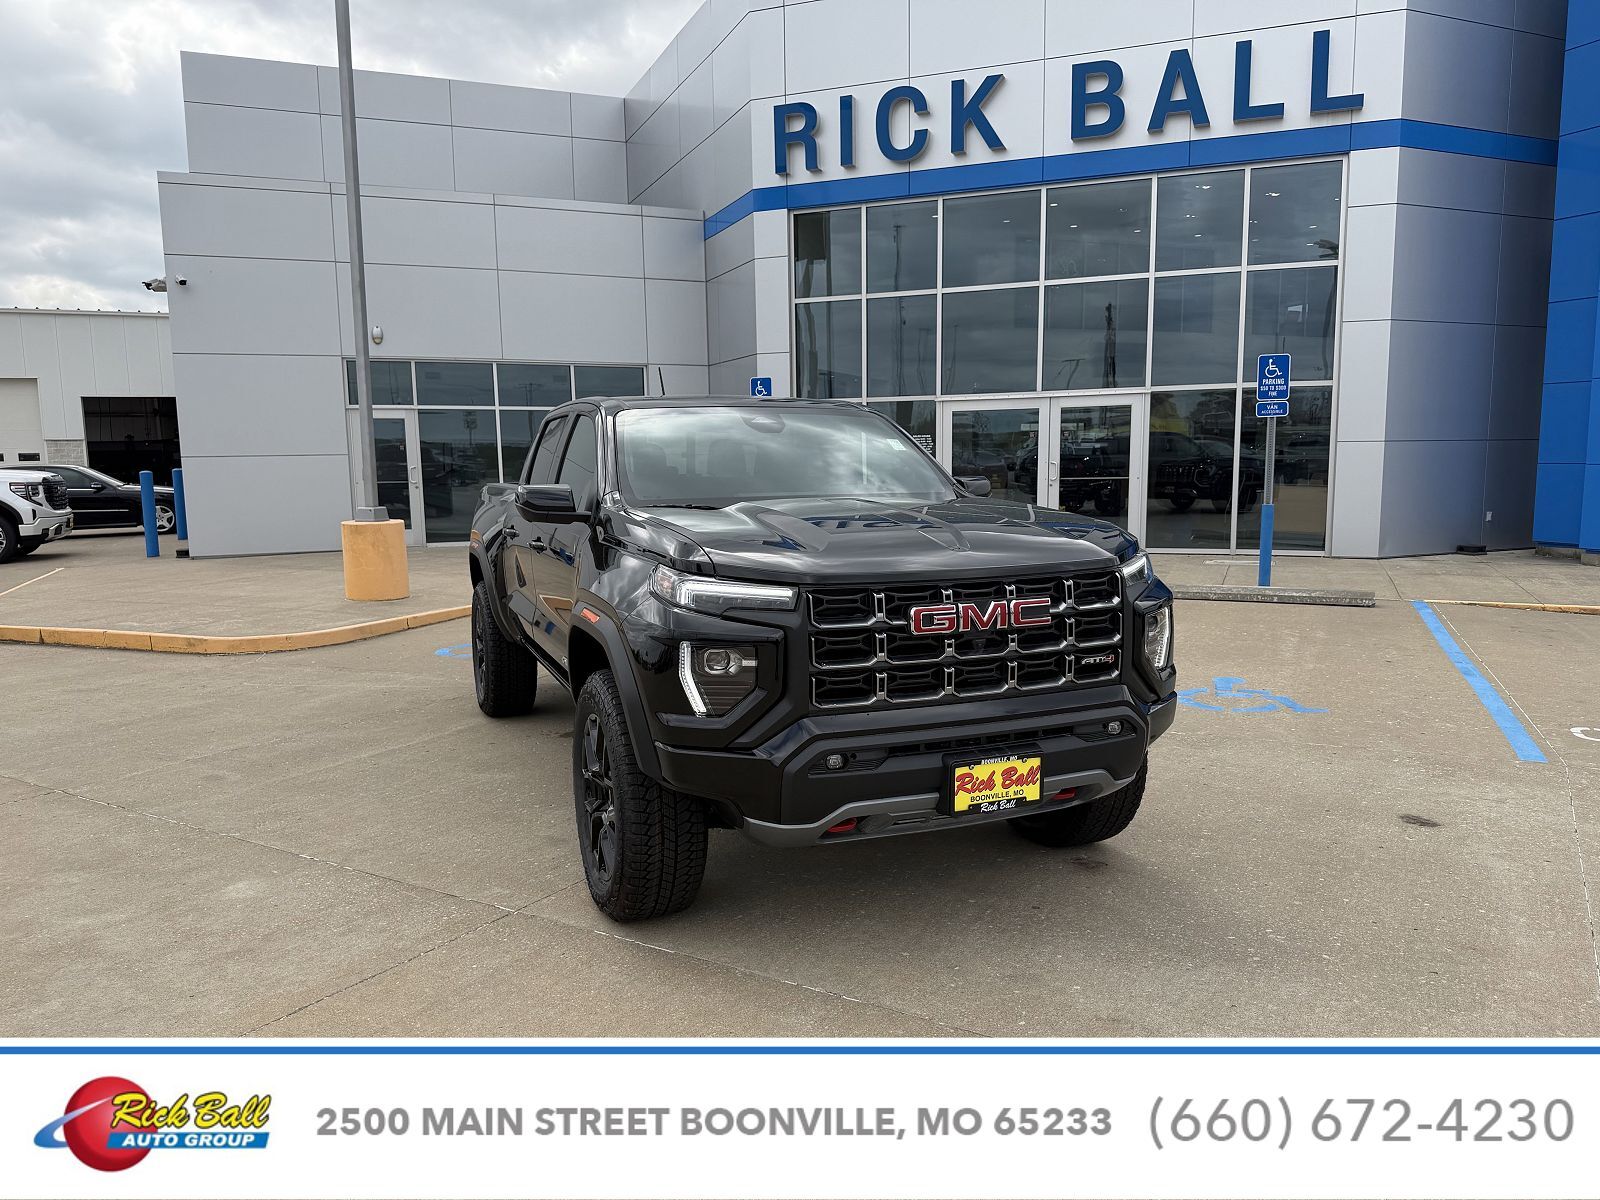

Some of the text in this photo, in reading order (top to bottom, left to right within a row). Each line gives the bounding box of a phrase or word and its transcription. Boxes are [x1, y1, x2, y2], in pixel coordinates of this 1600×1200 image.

[773, 29, 1365, 176] RICK BALL
[910, 598, 1052, 635] GMC
[955, 765, 1040, 796] Rick Ball
[970, 789, 1025, 802] BOONVILLE, MO
[980, 799, 1017, 813] Rick Ball
